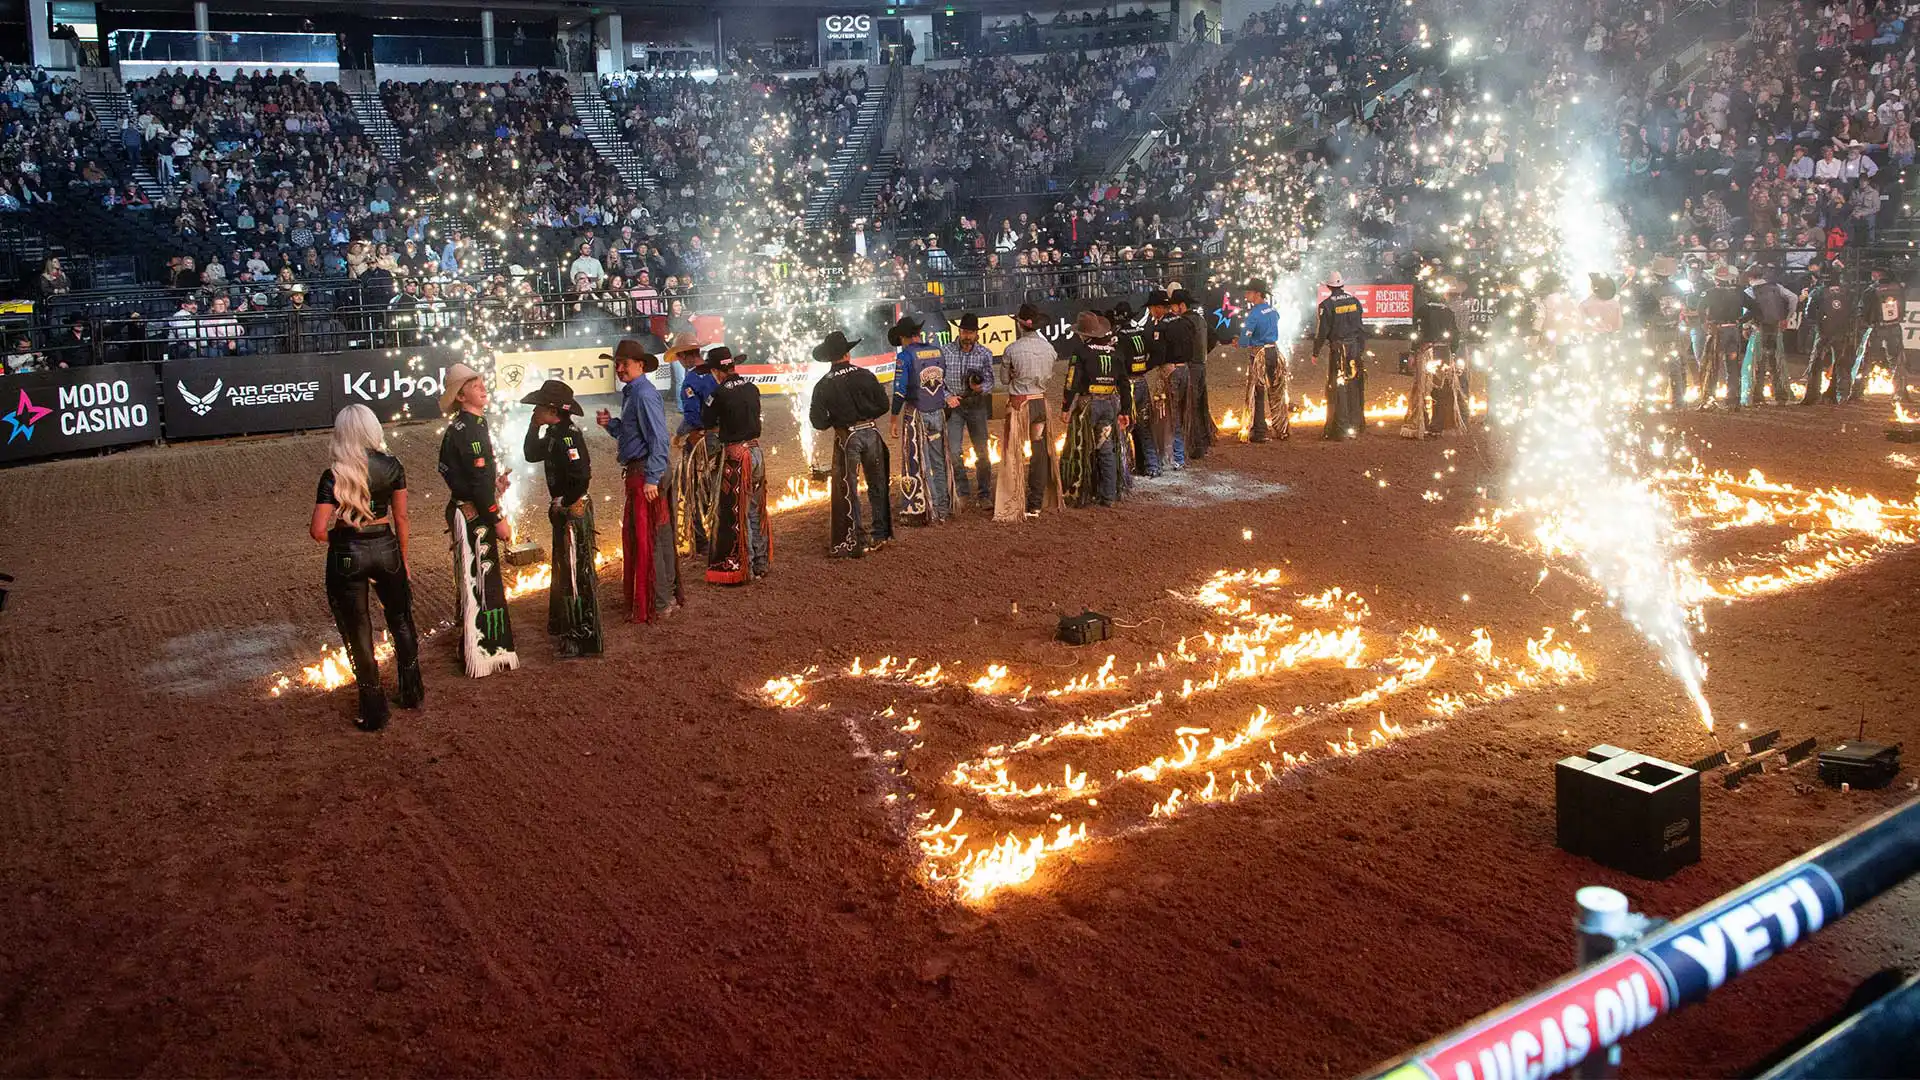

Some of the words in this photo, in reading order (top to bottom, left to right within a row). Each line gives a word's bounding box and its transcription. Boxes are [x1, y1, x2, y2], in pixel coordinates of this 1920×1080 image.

[826, 15, 870, 32] G2G
[1376, 291, 1410, 301] NICOTINE
[1376, 302, 1410, 312] POUCHES
[529, 364, 609, 382] ARIAT
[226, 386, 258, 397] AIR
[261, 381, 320, 395] FORCE
[343, 367, 446, 401] Kubot
[58, 380, 130, 410] MODO
[231, 391, 315, 407] RESERVE
[60, 404, 149, 436] CASINO
[1673, 877, 1824, 991] YETI
[1454, 1004, 1593, 1080] LUCAS
[1594, 972, 1658, 1046] OIL
